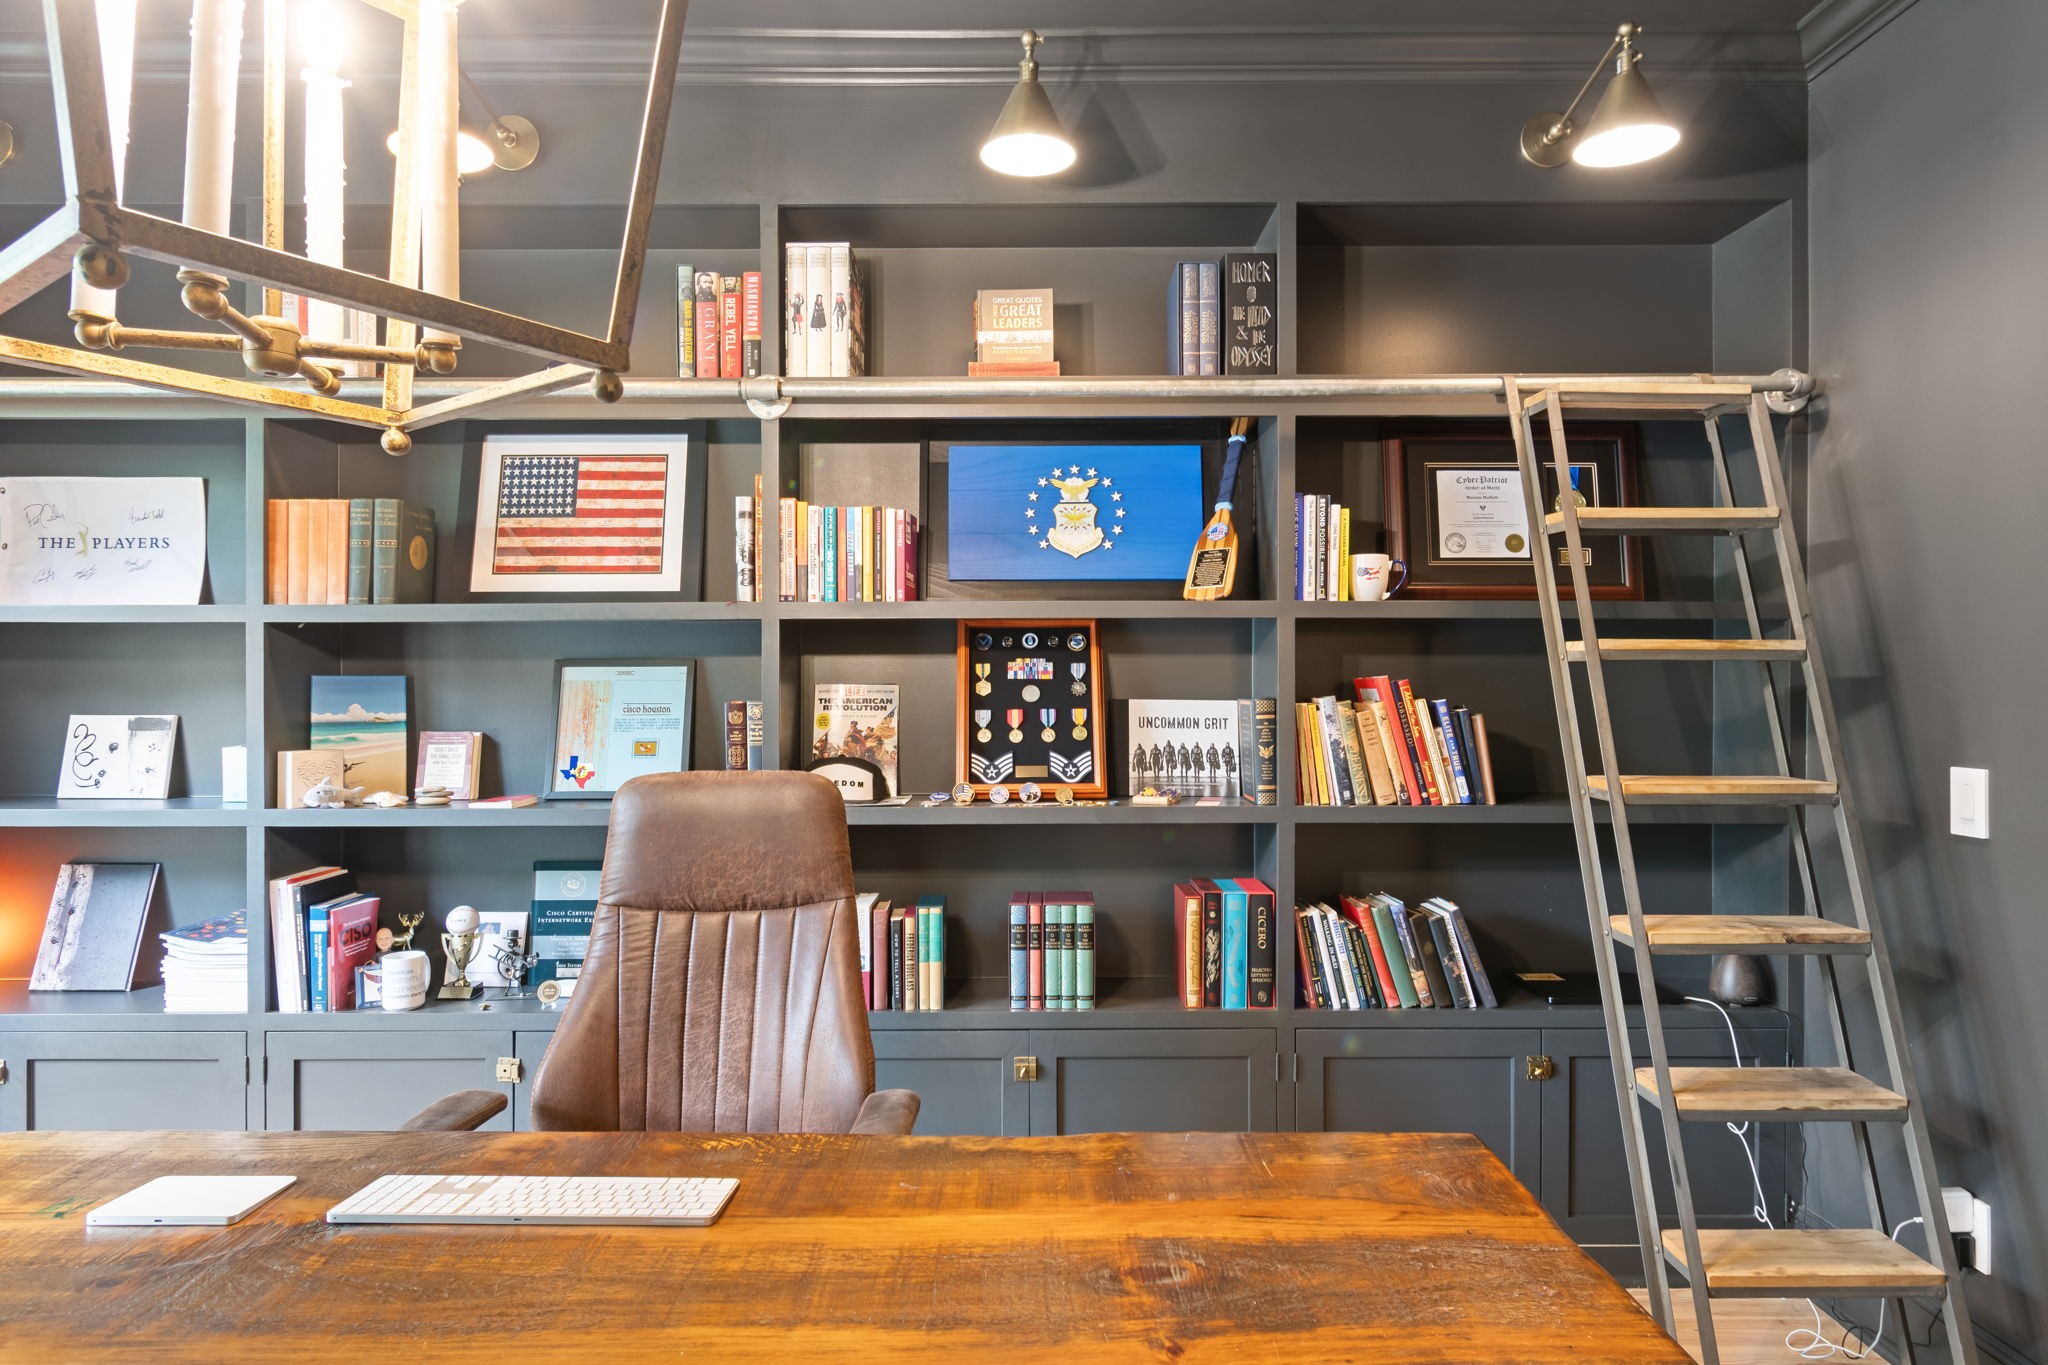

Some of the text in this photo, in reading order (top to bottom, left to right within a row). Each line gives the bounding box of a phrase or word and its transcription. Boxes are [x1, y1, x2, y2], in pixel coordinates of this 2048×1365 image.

[1231, 261, 1271, 283] HOMER
[747, 276, 758, 332] WASHINGTON
[999, 303, 1043, 317] GREAT
[1015, 296, 1042, 304] QUOTES
[725, 297, 736, 352] REBEL YELL
[992, 317, 1043, 329] LEADERS
[704, 307, 715, 363] GRANT
[1231, 345, 1273, 367] ODYSSEY
[38, 537, 170, 549] THE PLAYERS
[622, 704, 672, 714] cisco houston
[1138, 716, 1229, 730] UNCOMMON GRIT
[1397, 702, 1414, 747] OBSESSED!
[1442, 716, 1454, 739] ELITE
[1451, 750, 1462, 771] TRUE
[1347, 729, 1367, 796] WDERNESS
[834, 780, 864, 788] EDOM
[339, 922, 372, 946] CISO
[1257, 906, 1267, 950] CICERO
[894, 949, 899, 957] TO
[1322, 919, 1338, 969] WALKING IN MUD
[906, 932, 915, 992] FREDERICK DOUGLASS
